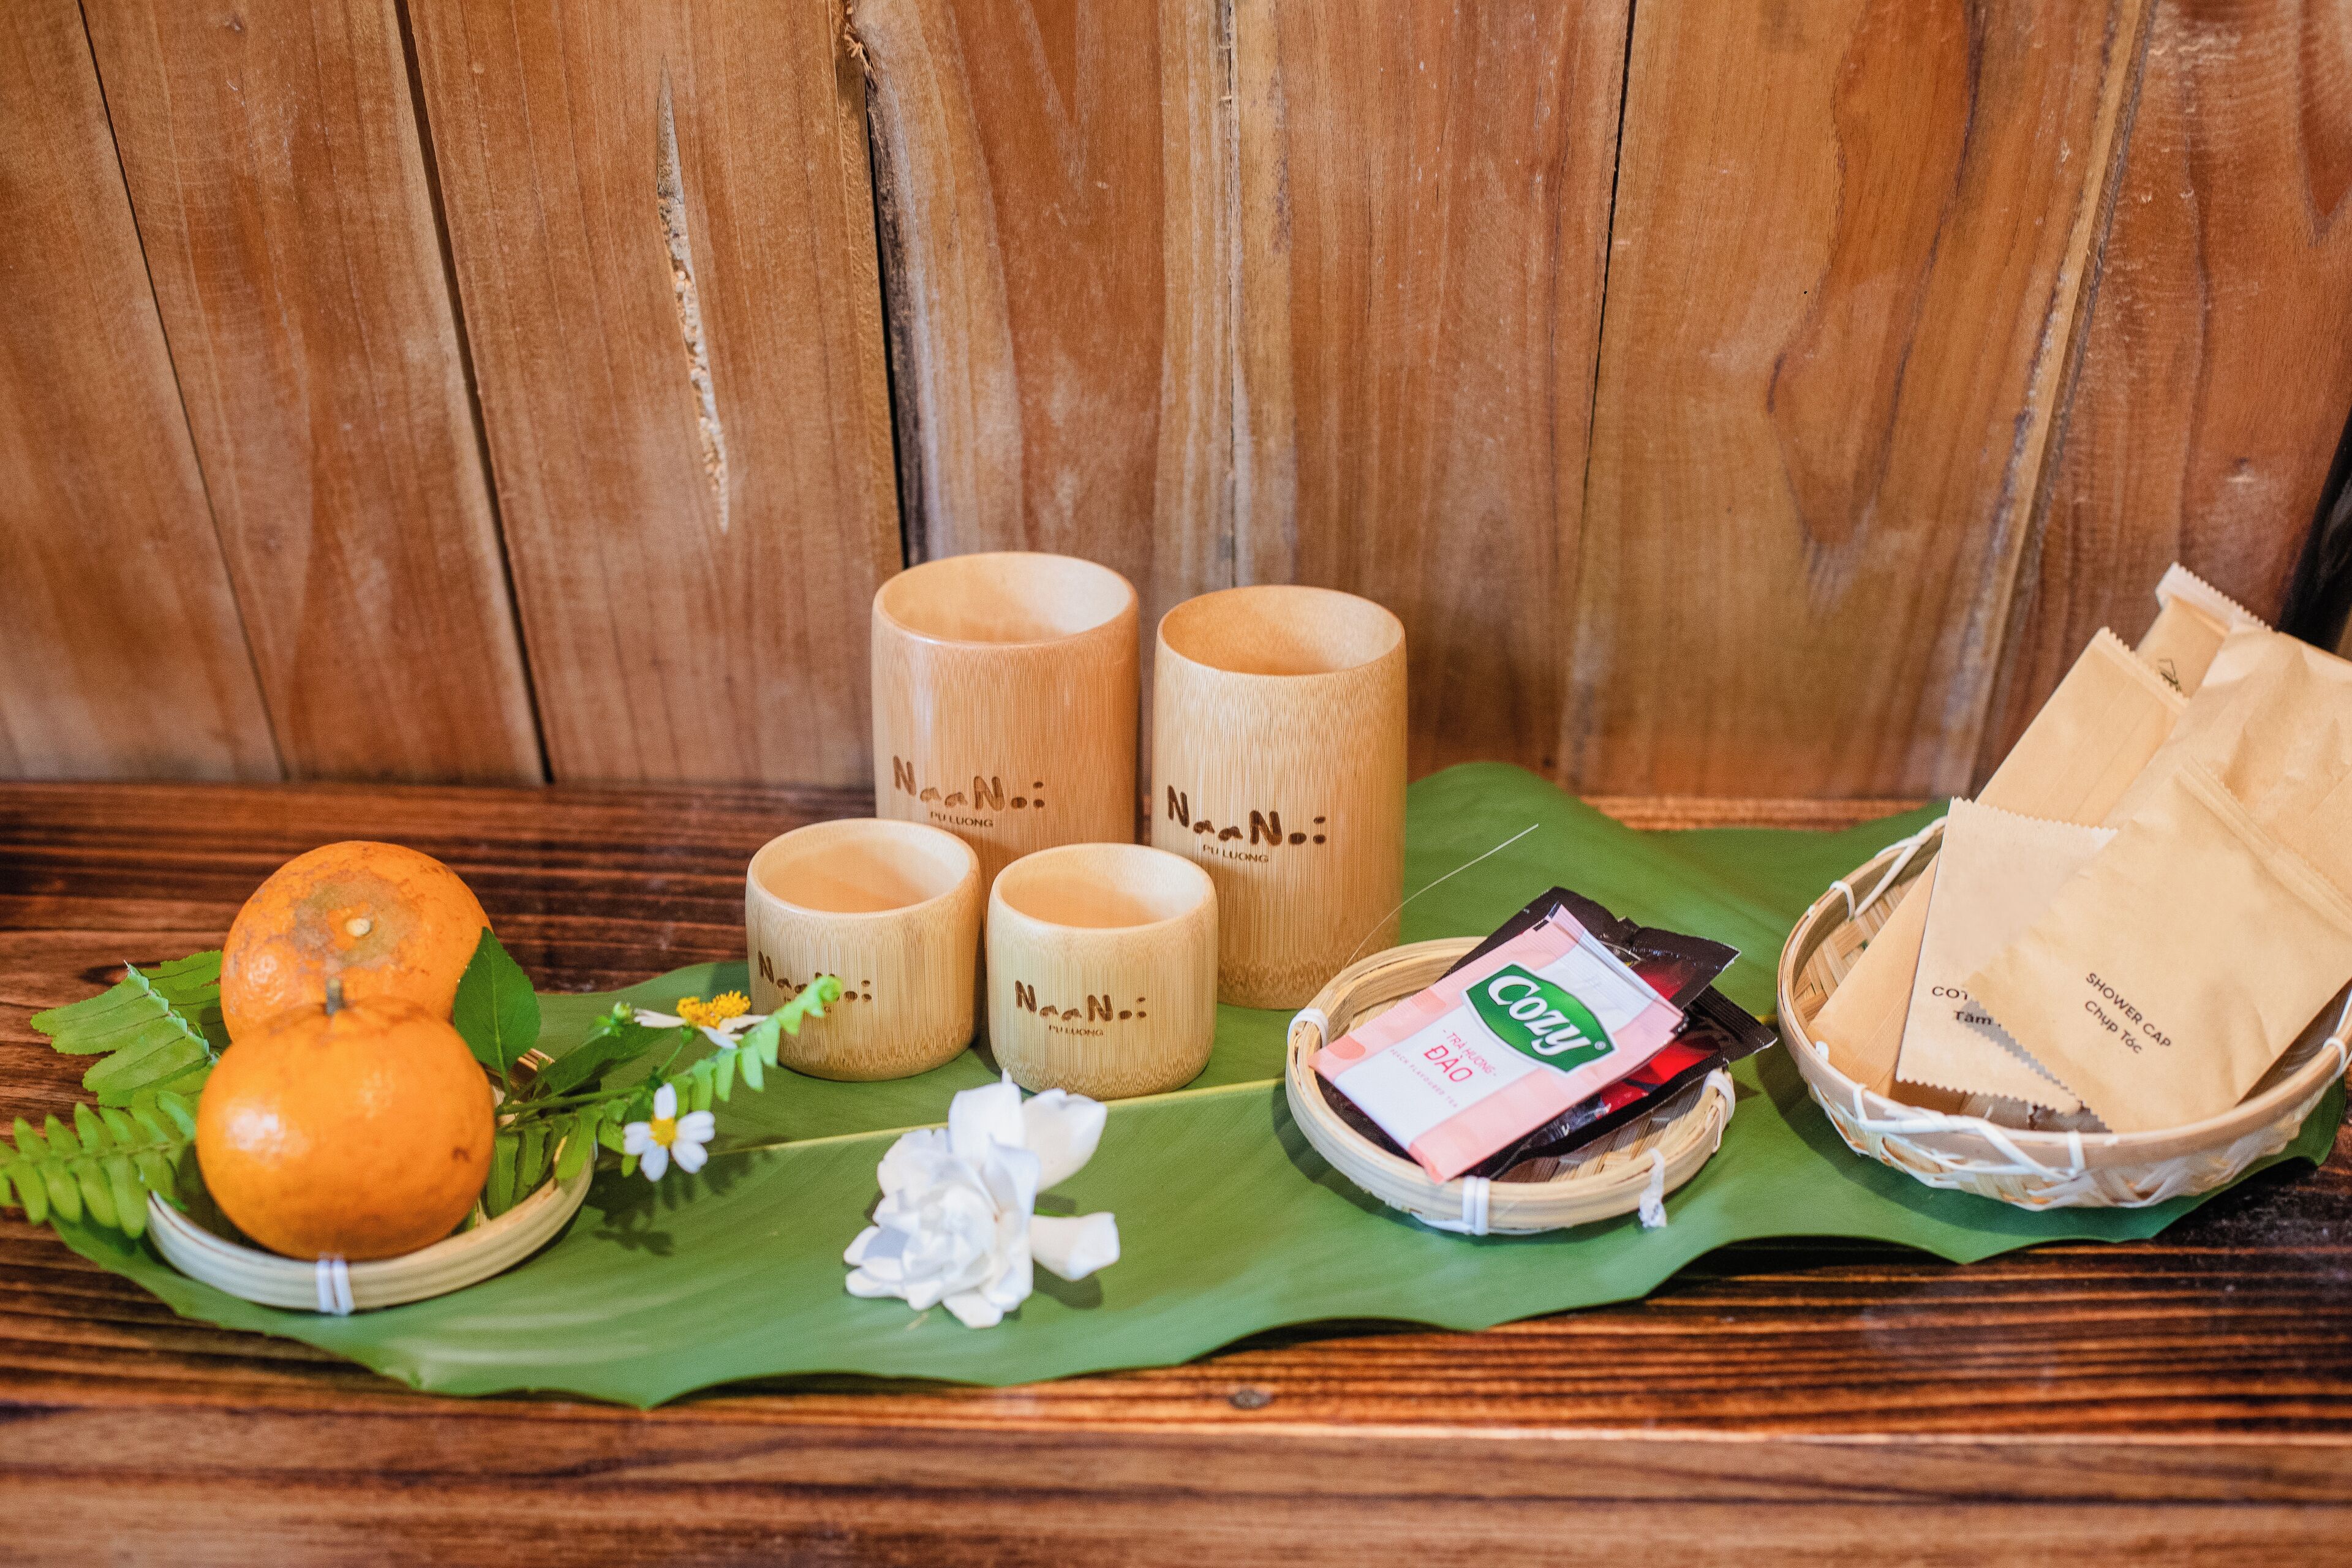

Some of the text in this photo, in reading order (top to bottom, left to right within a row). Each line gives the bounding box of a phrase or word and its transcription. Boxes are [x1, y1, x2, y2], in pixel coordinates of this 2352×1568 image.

[1488, 974, 1592, 1056] Cozy
[2084, 1000, 2142, 1054] Chụp Tóc
[2086, 972, 2171, 1047] SHOWER CAP
[1423, 1044, 1473, 1082] ĐÀO
